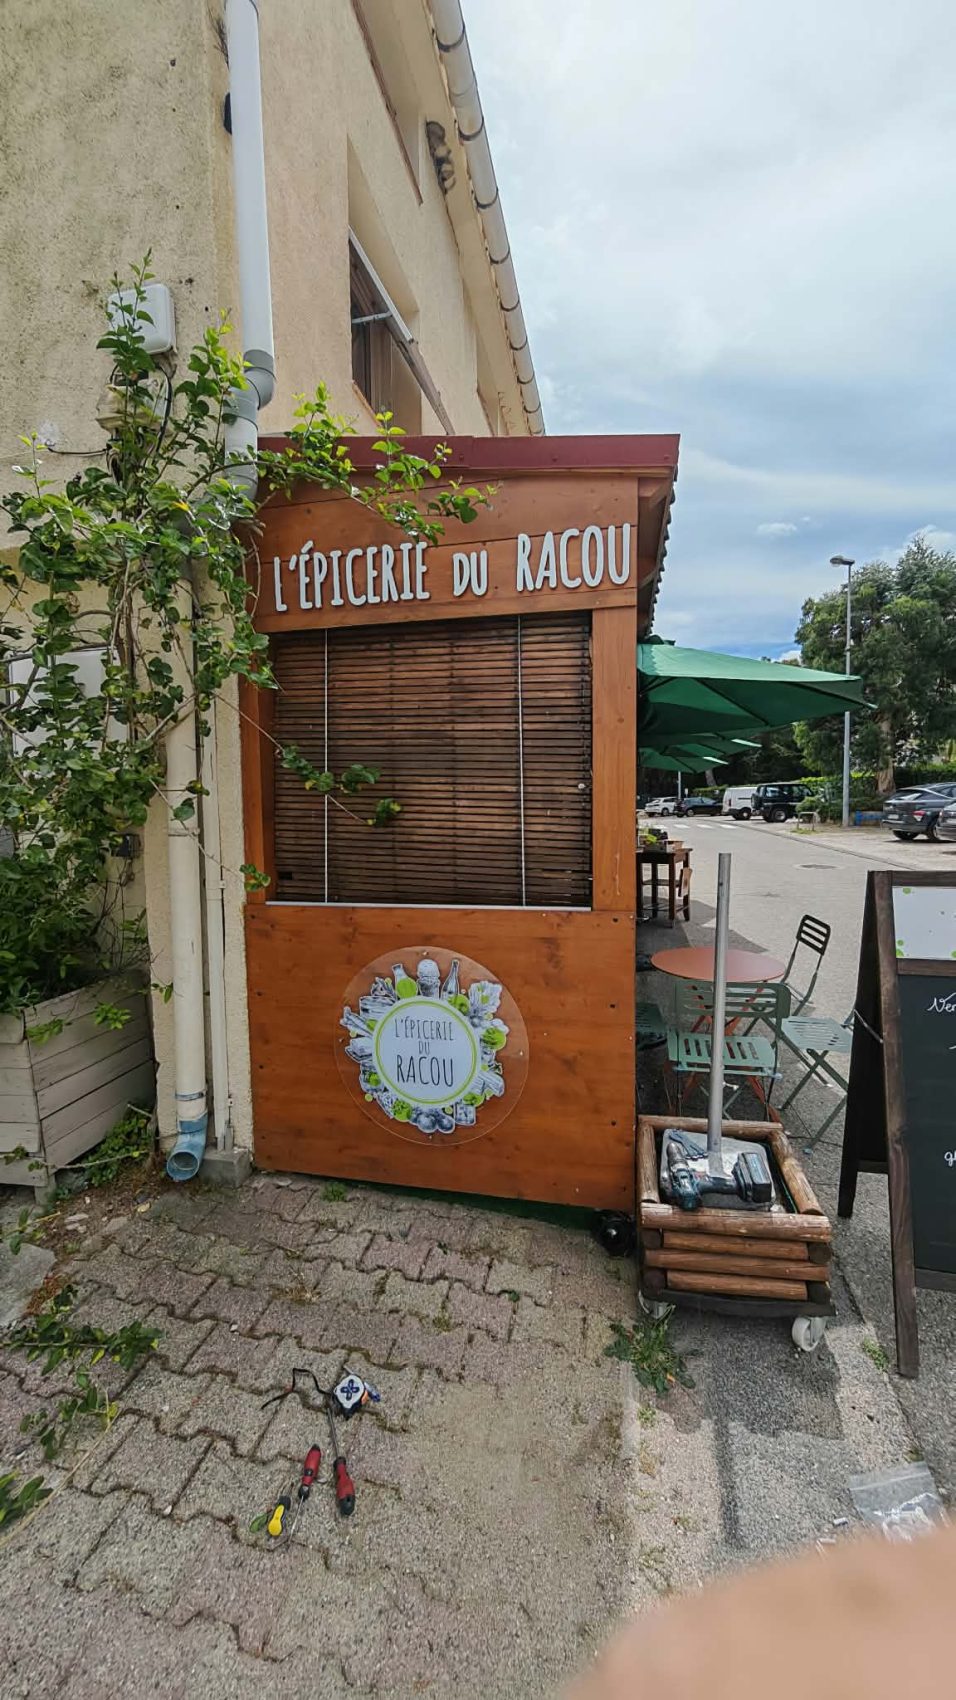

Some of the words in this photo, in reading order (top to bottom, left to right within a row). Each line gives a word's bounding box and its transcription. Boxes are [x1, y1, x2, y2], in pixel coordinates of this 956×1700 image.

[274, 540, 430, 612] L'ÉPICERIE
[452, 550, 488, 596] DU
[516, 523, 631, 592] RACOU
[395, 1016, 453, 1041] L'ÉPICERIE
[418, 1041, 430, 1055] DU
[396, 1054, 454, 1087] RACOU
